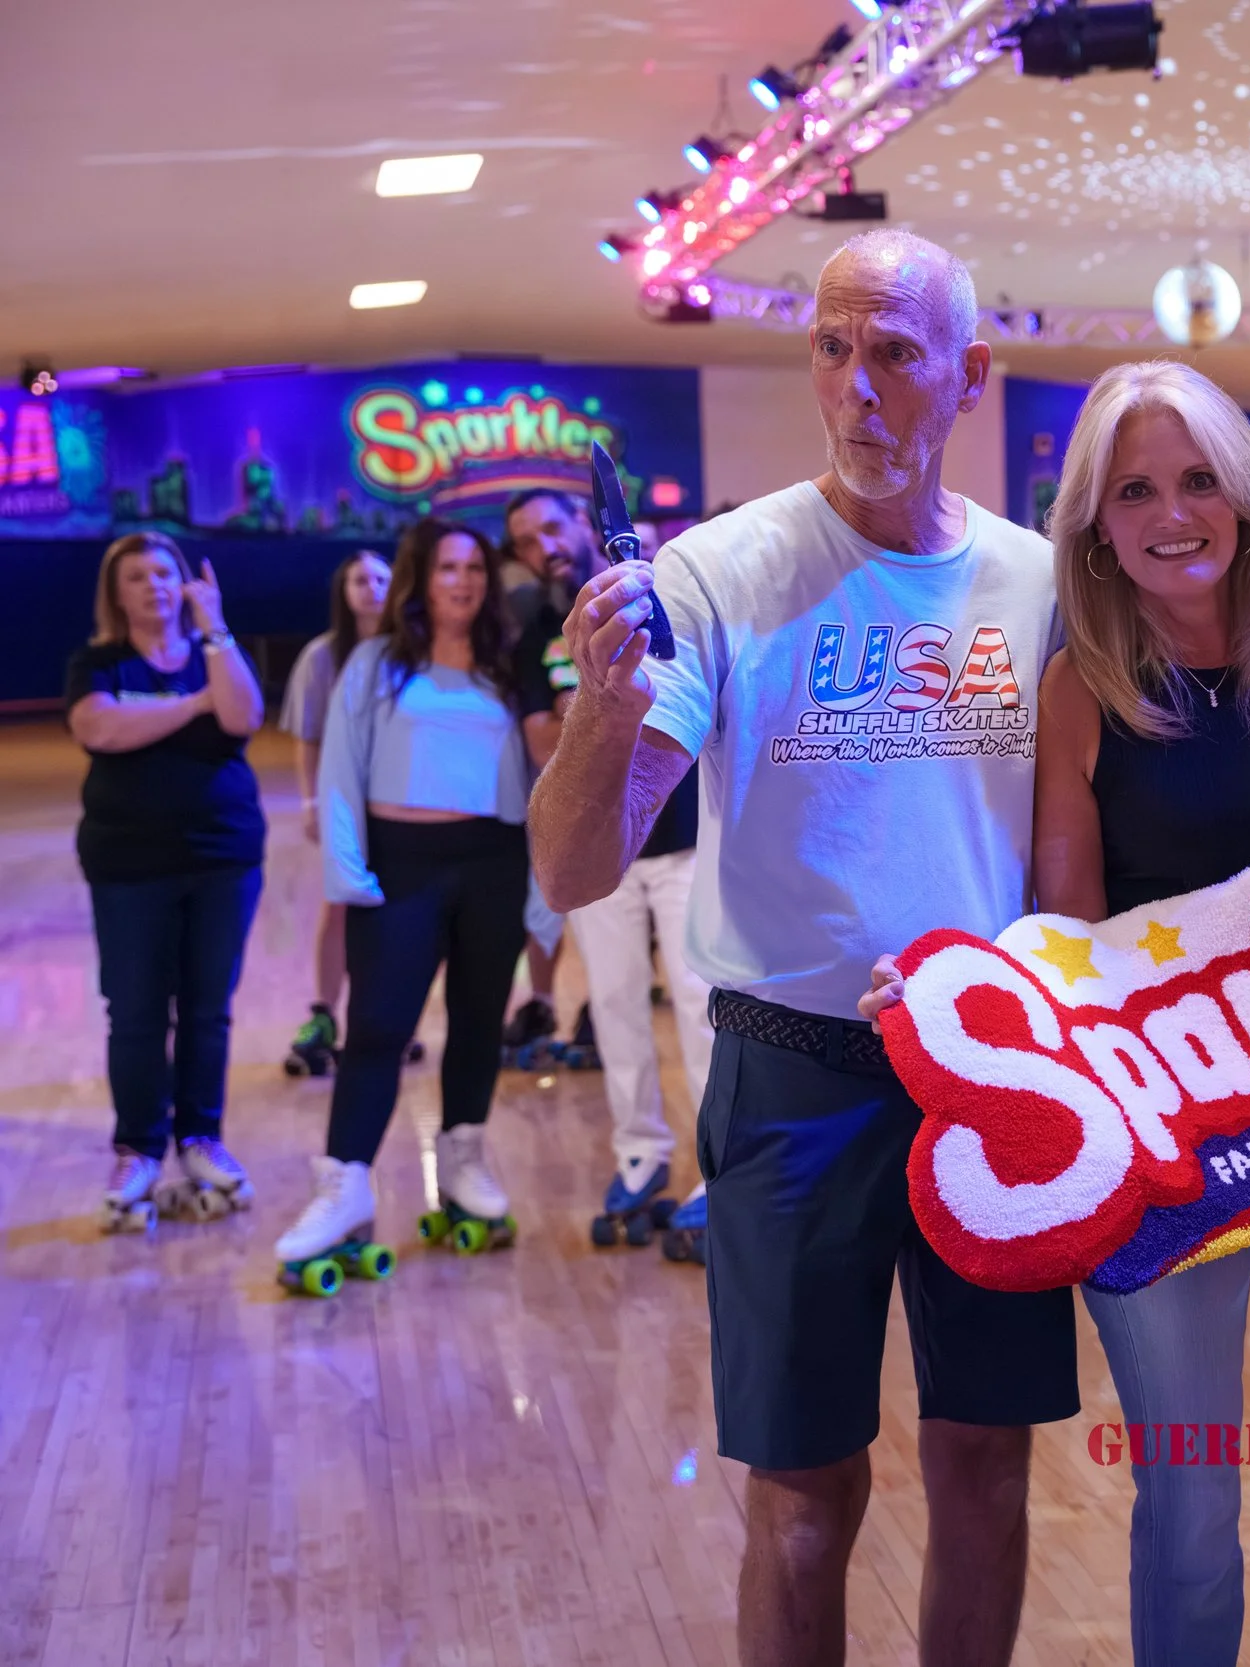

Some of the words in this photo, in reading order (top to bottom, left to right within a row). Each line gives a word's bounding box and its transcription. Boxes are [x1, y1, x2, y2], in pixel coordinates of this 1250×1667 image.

[356, 393, 614, 487] Sparkles
[808, 622, 1021, 713] USA
[772, 738, 837, 764] Where
[836, 738, 869, 761] the
[868, 736, 926, 763] World
[924, 739, 980, 758] comes
[979, 733, 999, 755] to
[798, 711, 916, 735] SHUFFLE
[921, 707, 1029, 734] SKATERS
